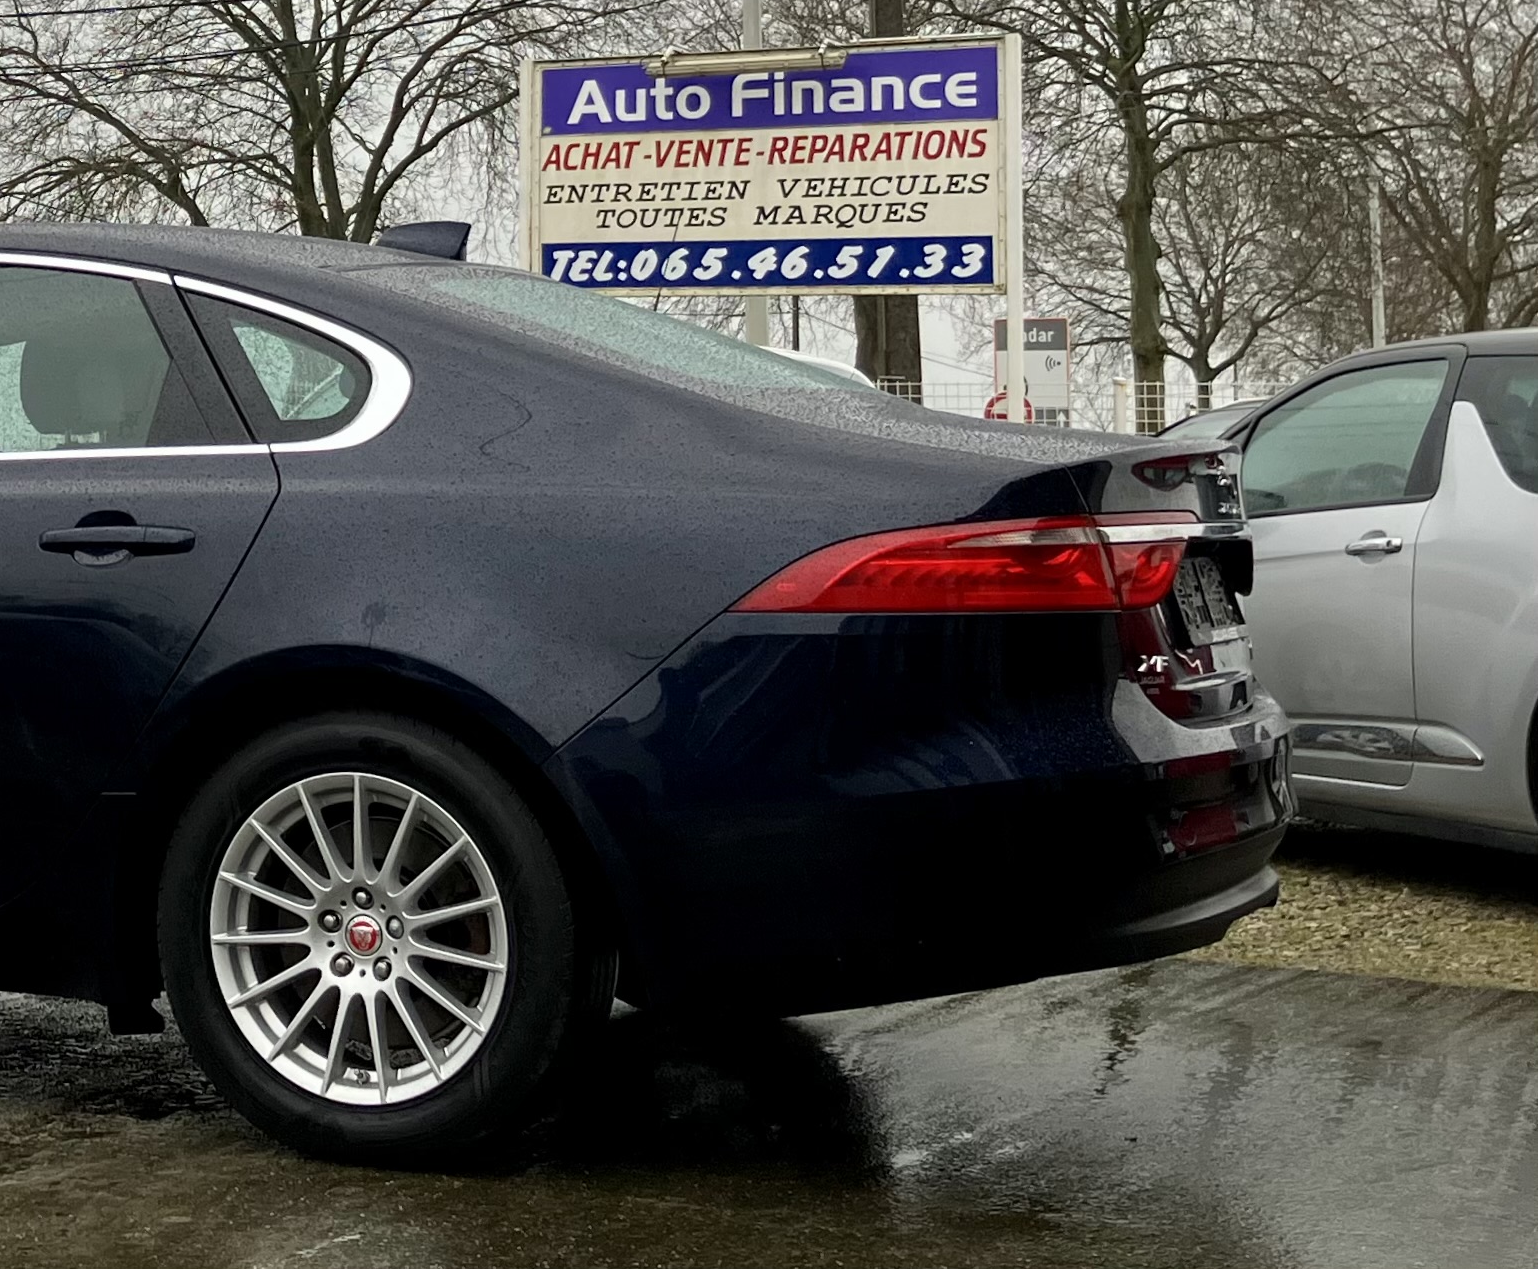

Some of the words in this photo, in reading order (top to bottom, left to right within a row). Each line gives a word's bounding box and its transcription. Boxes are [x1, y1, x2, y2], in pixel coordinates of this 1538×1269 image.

[566, 78, 711, 125] Auto
[730, 71, 978, 118] Finance
[543, 180, 751, 205] ENTRETIEN
[776, 173, 990, 199] VEHICULES
[595, 207, 728, 229] TOUTES
[753, 202, 929, 229] MARQUES
